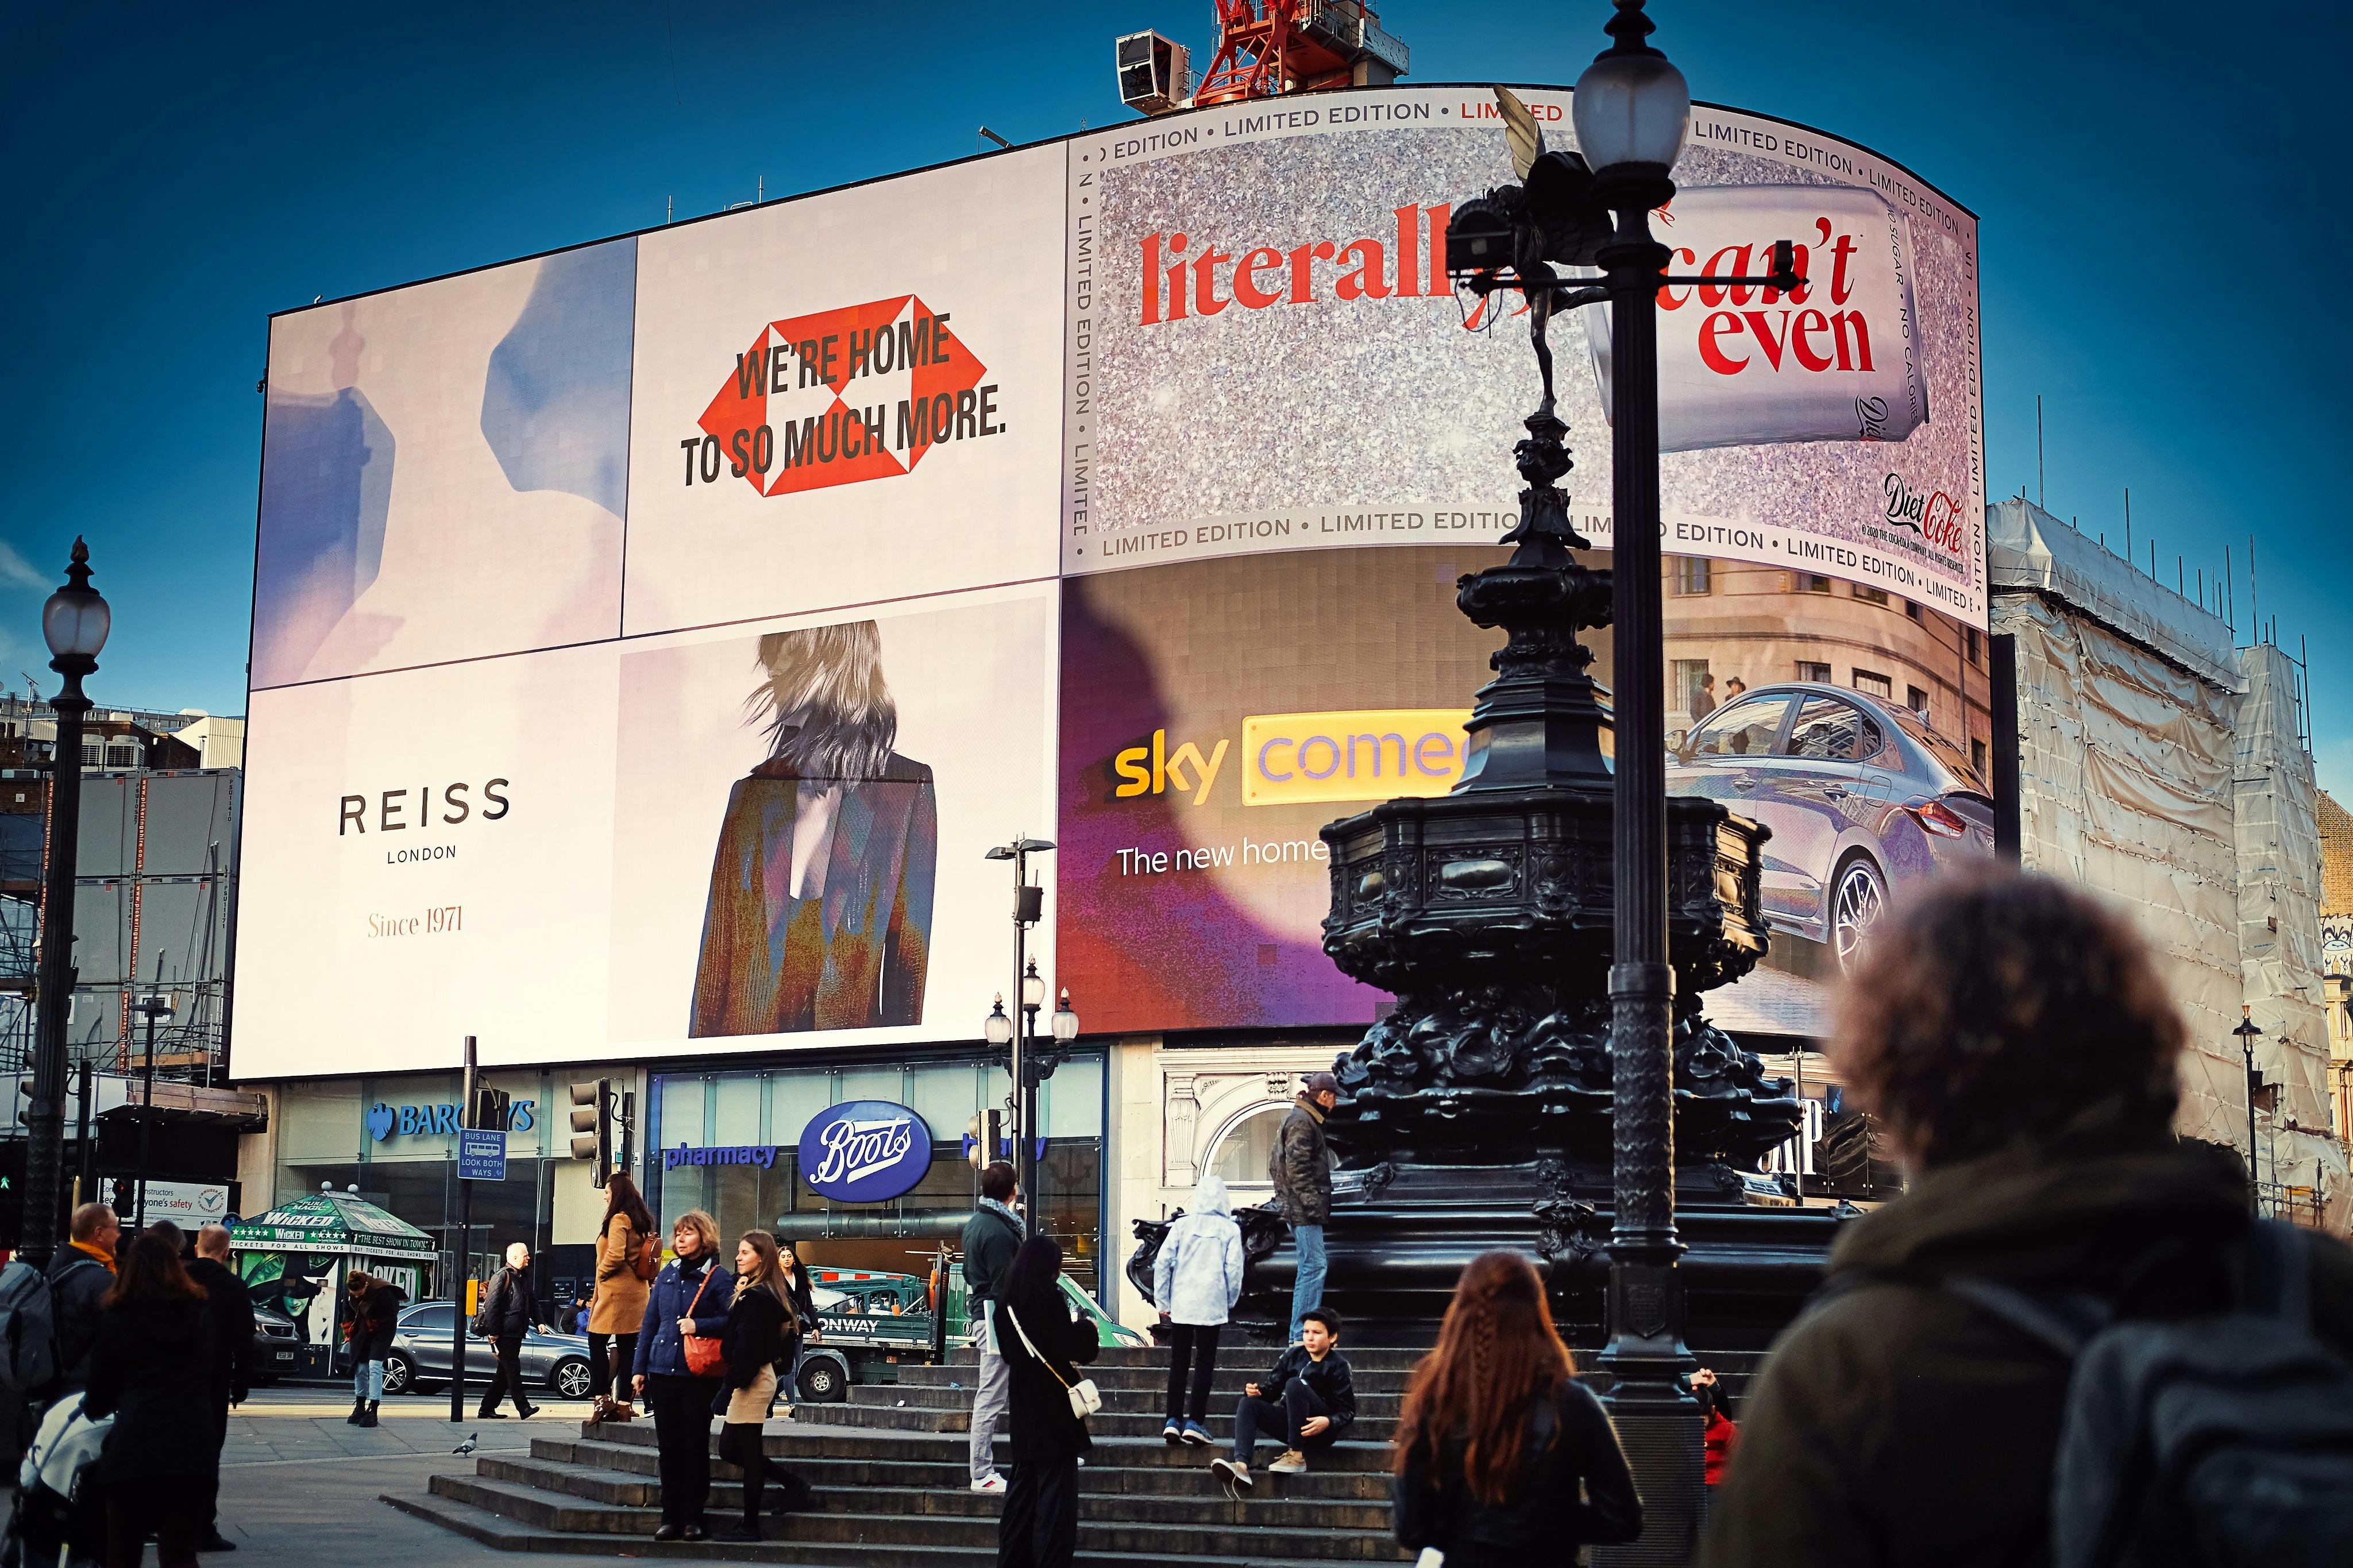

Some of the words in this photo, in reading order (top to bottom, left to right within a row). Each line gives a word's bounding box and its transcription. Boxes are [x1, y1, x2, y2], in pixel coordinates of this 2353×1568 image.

[1114, 126, 1198, 159] EDITION
[1224, 110, 1320, 137] LIMITED
[1331, 103, 1430, 124] EDITION
[1461, 103, 1563, 121] LIMED
[1695, 121, 1778, 152] LIMITED
[1784, 140, 1852, 176] EDITION
[1869, 169, 1916, 207] LIMITED
[1920, 197, 1958, 236] EDITION
[1078, 215, 1092, 310] LIMITED
[1889, 225, 1903, 285] SUGAR
[736, 334, 838, 399] WE'RE
[850, 312, 951, 380] HOME
[1699, 308, 1876, 375] even
[1900, 308, 1909, 339] NO
[1966, 307, 1977, 397] EDITION
[1076, 319, 1090, 415] EDITION
[1904, 347, 1918, 424] CALORIES
[681, 434, 721, 486] TO
[731, 424, 773, 478] SO
[785, 404, 885, 470] MUCH
[897, 384, 1006, 450] MORE.
[1969, 405, 1980, 496] LIMITED
[1103, 530, 1188, 557] LIMITED
[1197, 519, 1290, 543] EDITION
[1321, 513, 1424, 532] LIMITED
[1434, 512, 1518, 530] EDITIO
[1866, 526, 1878, 538] 2020
[1879, 529, 1888, 541] THE
[1935, 553, 1947, 567] RIGHTS
[1884, 473, 1926, 524] Diet
[1924, 491, 1964, 553] Coke
[1677, 522, 1763, 549] EDITION
[1788, 538, 1857, 567] LIMITED
[1862, 555, 1914, 586] EDITION
[1927, 578, 1966, 609] LIMITED
[1115, 729, 1229, 805] sky
[340, 778, 510, 836] REISS
[387, 845, 456, 864] LONDON
[1116, 847, 1168, 876] The
[1175, 843, 1234, 871] new
[1243, 836, 1329, 867] home
[368, 913, 419, 938] Since
[426, 906, 462, 933] 1971
[666, 1142, 778, 1171] pharmacy
[809, 1117, 912, 1184] Boots
[169, 1200, 193, 1211] safety
[372, 1236, 385, 1245] BEST
[385, 1237, 402, 1247] SHOW
[403, 1239, 410, 1248] IN
